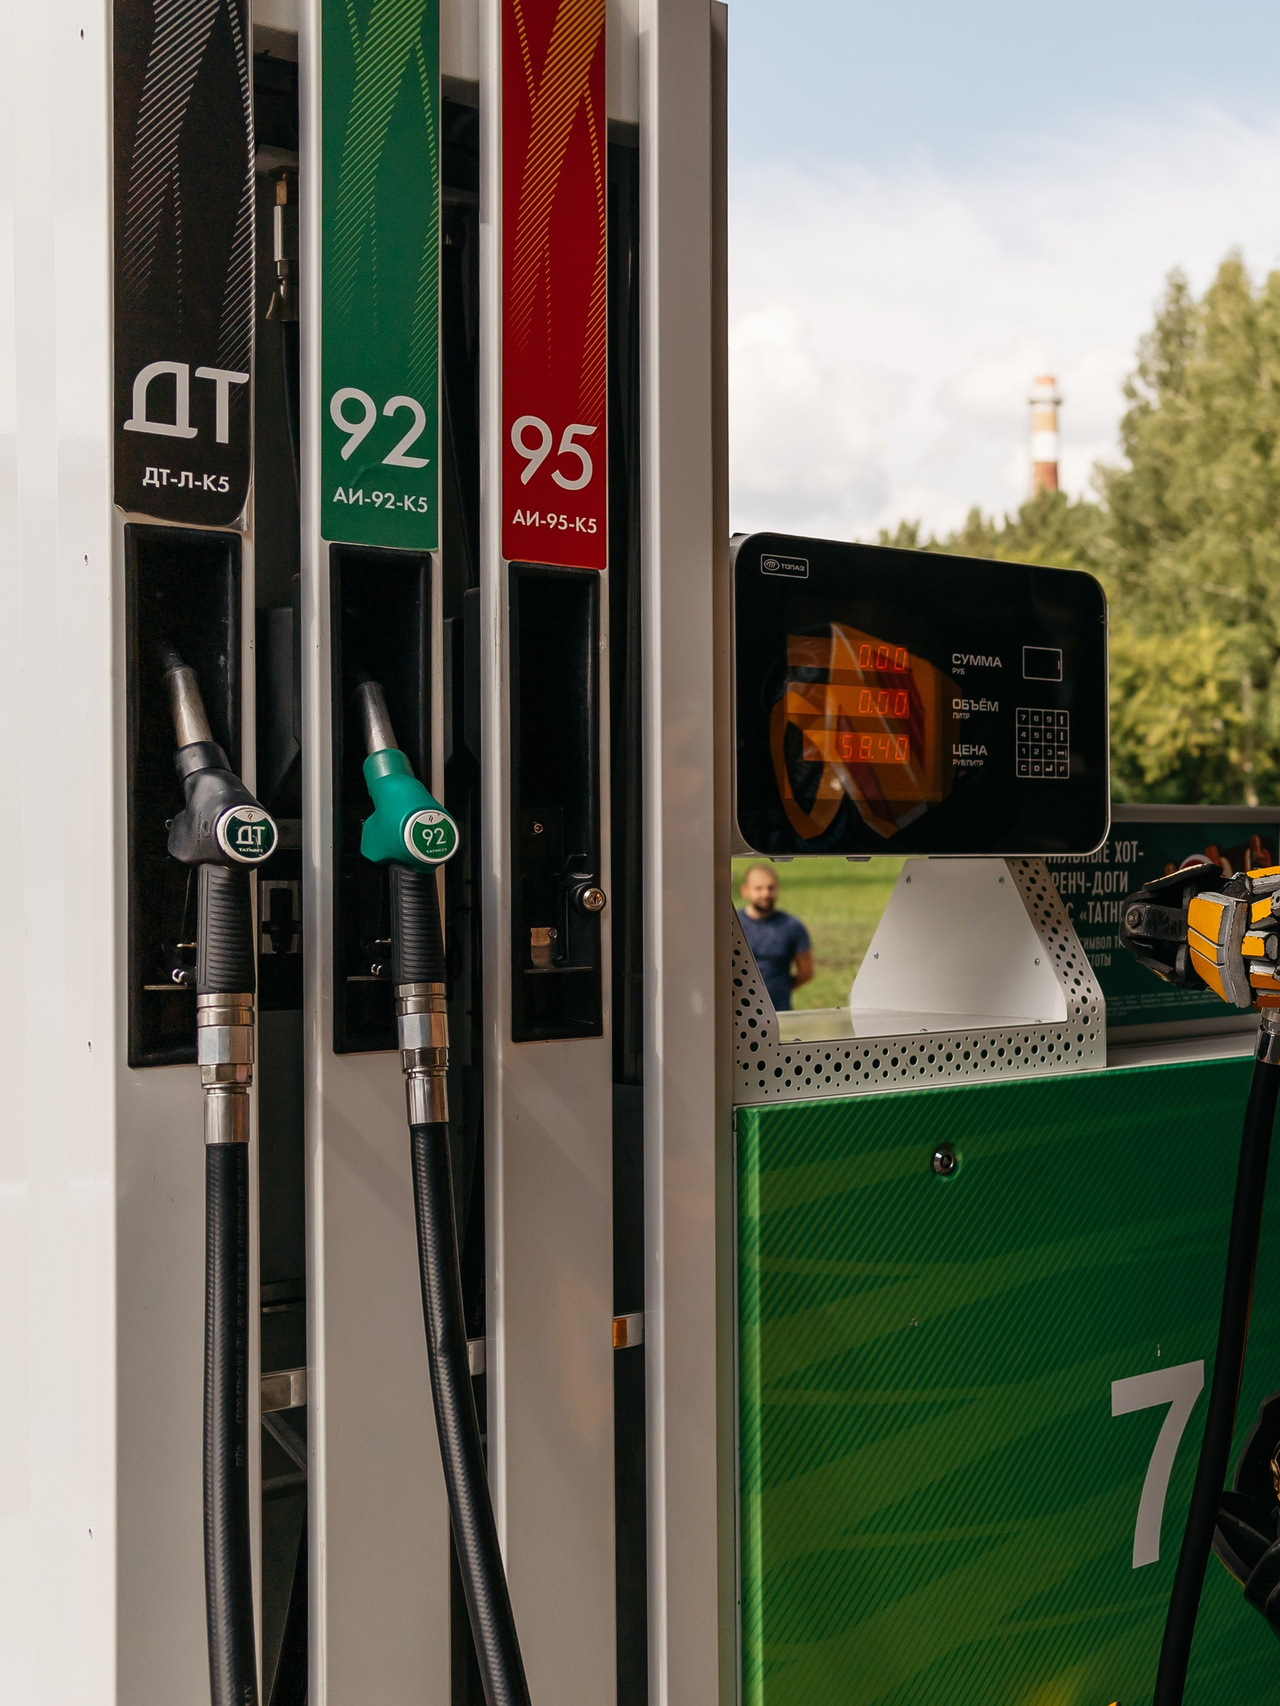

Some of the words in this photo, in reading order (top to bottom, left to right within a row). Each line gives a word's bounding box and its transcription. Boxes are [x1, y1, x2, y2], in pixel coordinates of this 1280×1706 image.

[123, 361, 250, 444] ДТ
[329, 387, 430, 468] 92
[511, 416, 598, 490] 95
[142, 466, 230, 493] ДТ-Л-К5
[333, 487, 428, 513] АИ-92-К5
[512, 509, 597, 534] АИ-95-К5
[780, 563, 805, 572] ТОПАЗ
[858, 644, 907, 671] 0.00
[952, 653, 1002, 668] СУММА
[858, 689, 907, 715] 0.00
[952, 698, 999, 712] ОБЪЁМ
[841, 734, 908, 761] 58.40
[952, 744, 988, 757] ЦЕНА
[236, 825, 265, 845] ДТ
[422, 827, 447, 846] 92
[1114, 841, 1144, 863] ХОТ-
[1051, 871, 1128, 895] РЕНЧ-ДОГИ
[1111, 1359, 1204, 1569] 7
